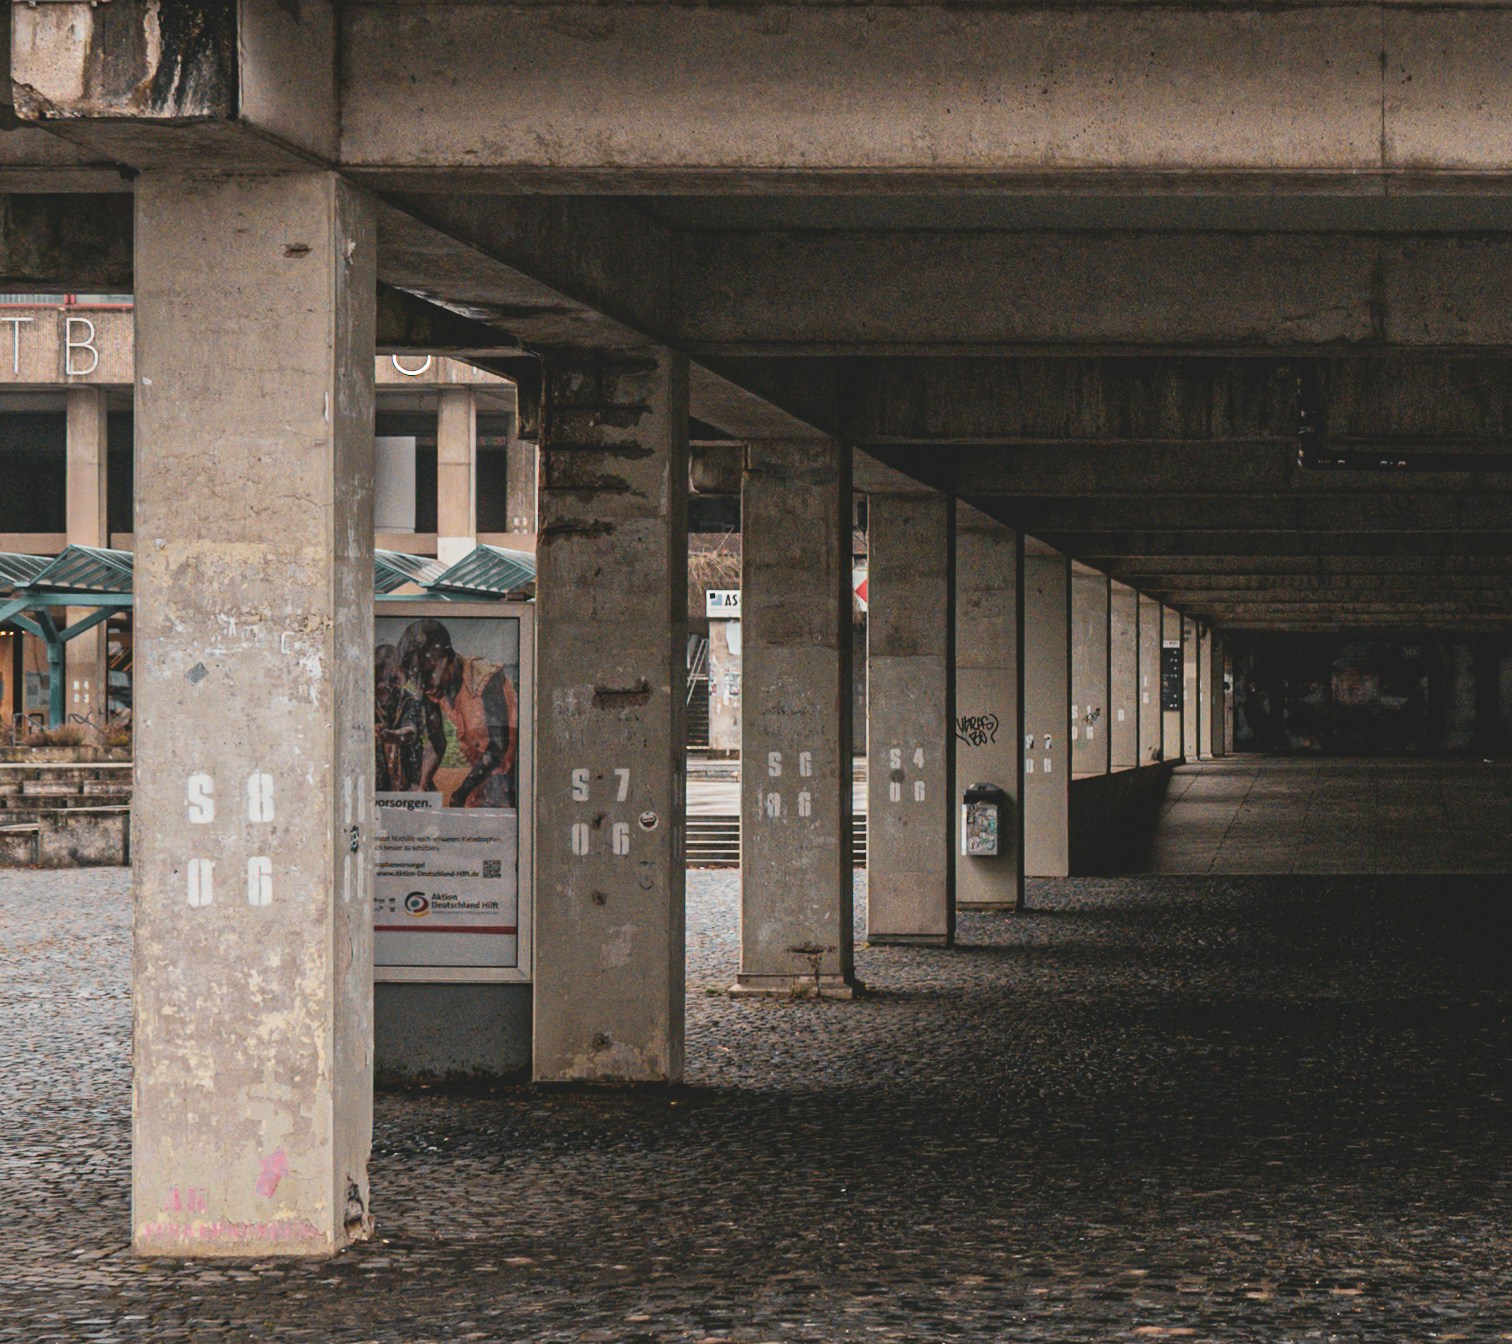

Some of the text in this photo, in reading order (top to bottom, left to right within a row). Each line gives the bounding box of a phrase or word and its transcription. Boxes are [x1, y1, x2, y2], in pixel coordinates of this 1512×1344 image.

[431, 892, 458, 901] Aktion
[431, 900, 499, 910] Deutschland Hilft
